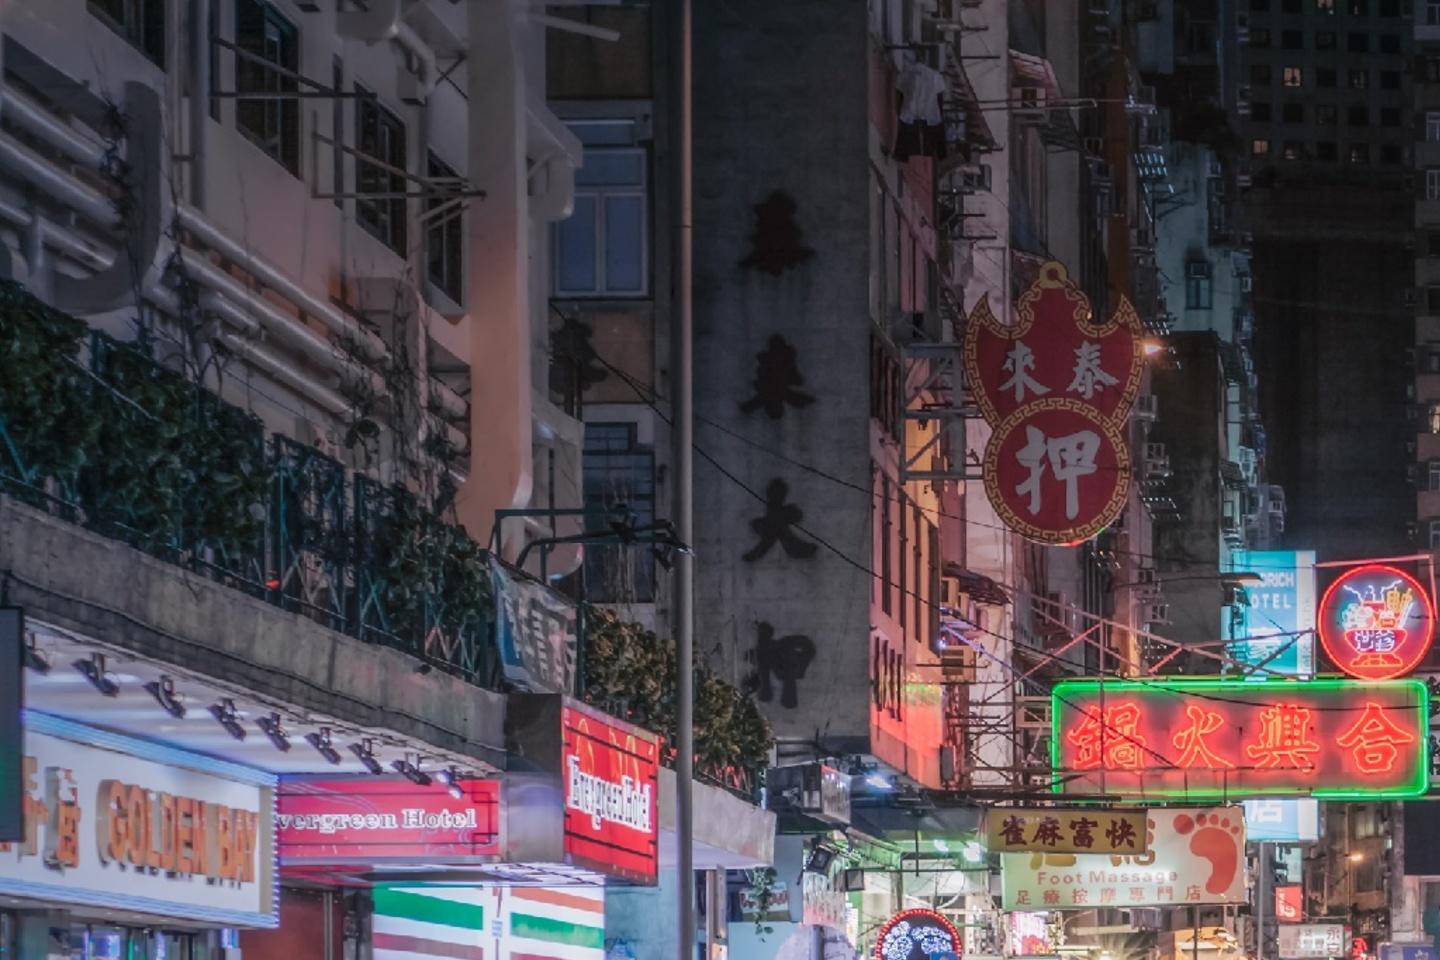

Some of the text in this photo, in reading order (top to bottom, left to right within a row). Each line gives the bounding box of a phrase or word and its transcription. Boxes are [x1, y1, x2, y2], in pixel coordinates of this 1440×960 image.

[1015, 425, 1101, 520] 押
[1250, 592, 1291, 609] OTEL
[567, 754, 653, 833] Evergreen Hotel
[97, 779, 208, 876] GOLDEN
[207, 803, 260, 883] BAY
[279, 808, 477, 834] vergreen Hotel
[1037, 870, 1178, 886] Foot Massage
[1016, 886, 1201, 905] 足療按摩專門店
